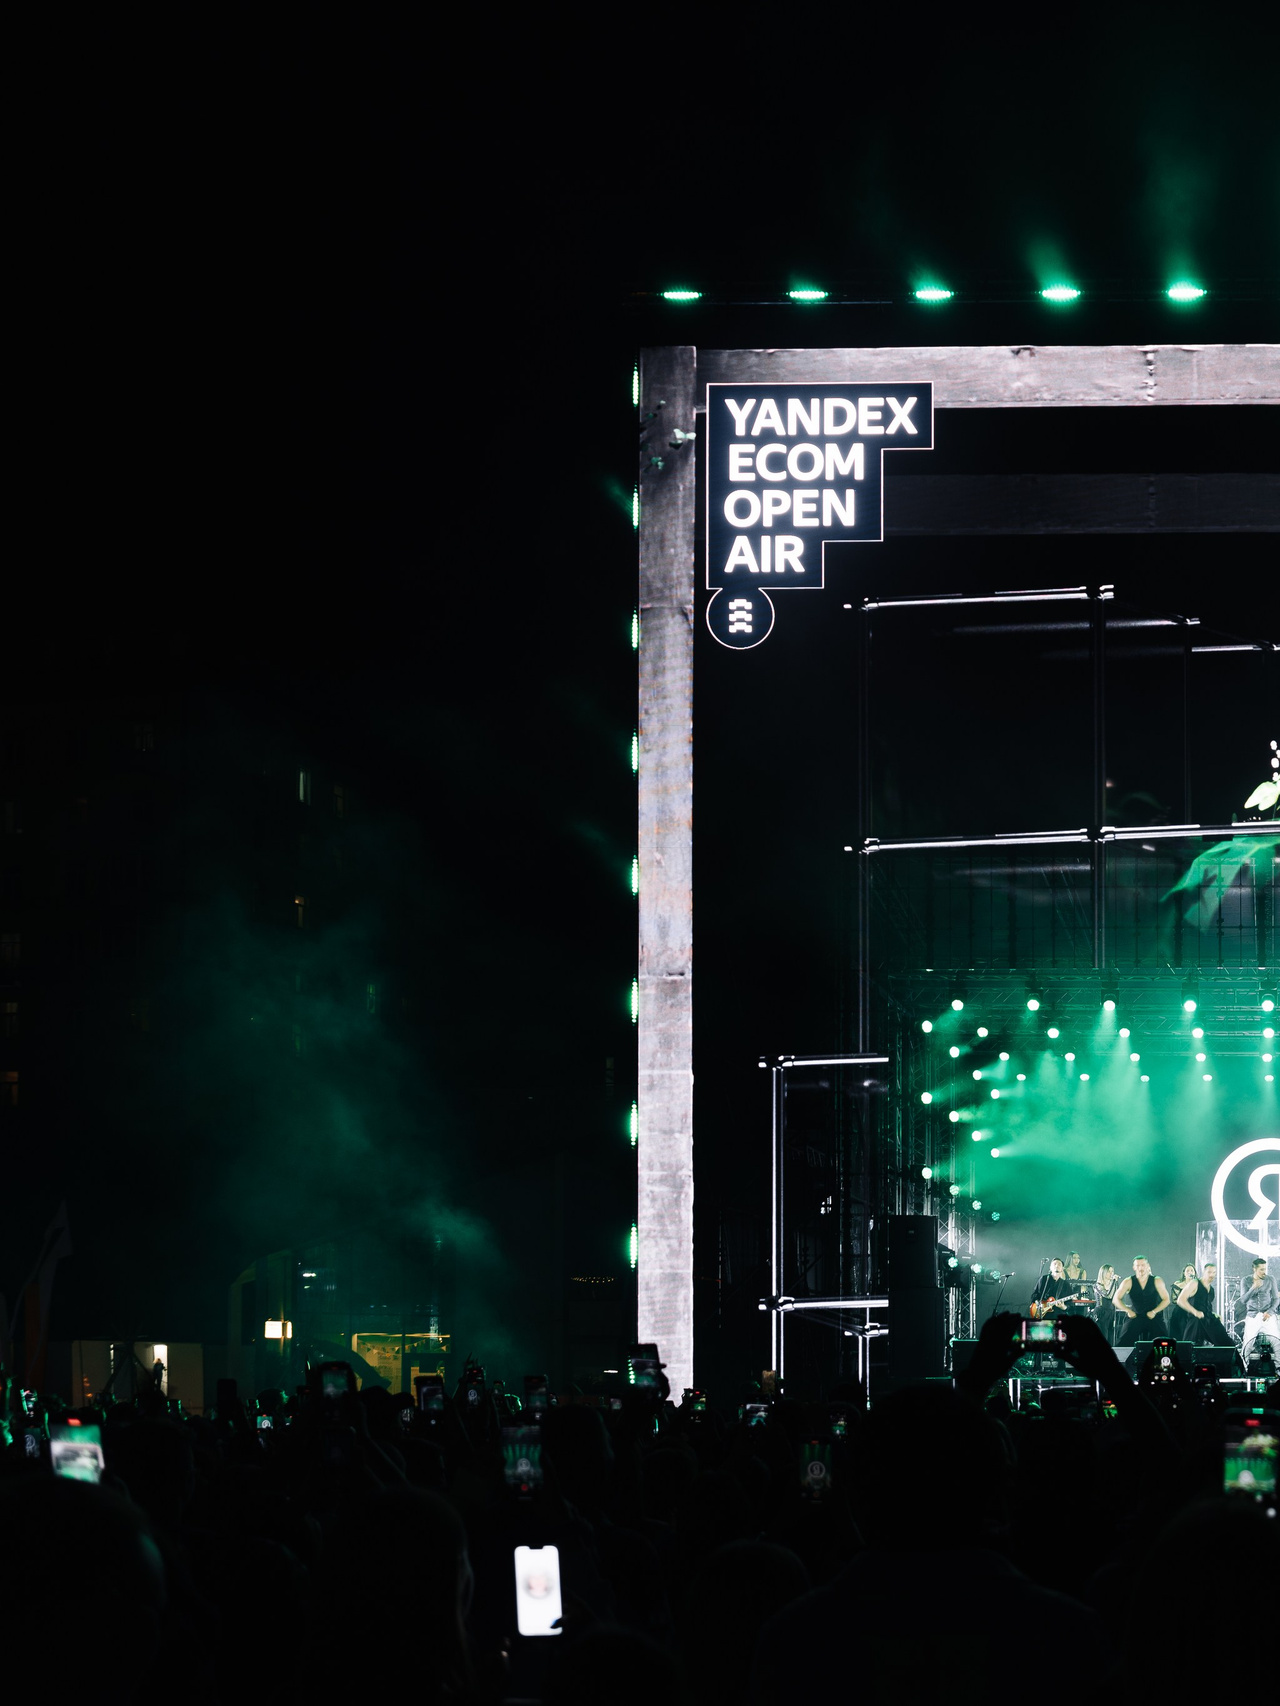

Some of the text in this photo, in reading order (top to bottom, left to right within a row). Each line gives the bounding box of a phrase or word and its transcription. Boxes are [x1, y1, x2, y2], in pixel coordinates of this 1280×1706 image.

[724, 396, 919, 437] YANDEX
[728, 442, 865, 482] ECOM
[723, 488, 856, 528] OPEN
[723, 534, 806, 573] AIR
